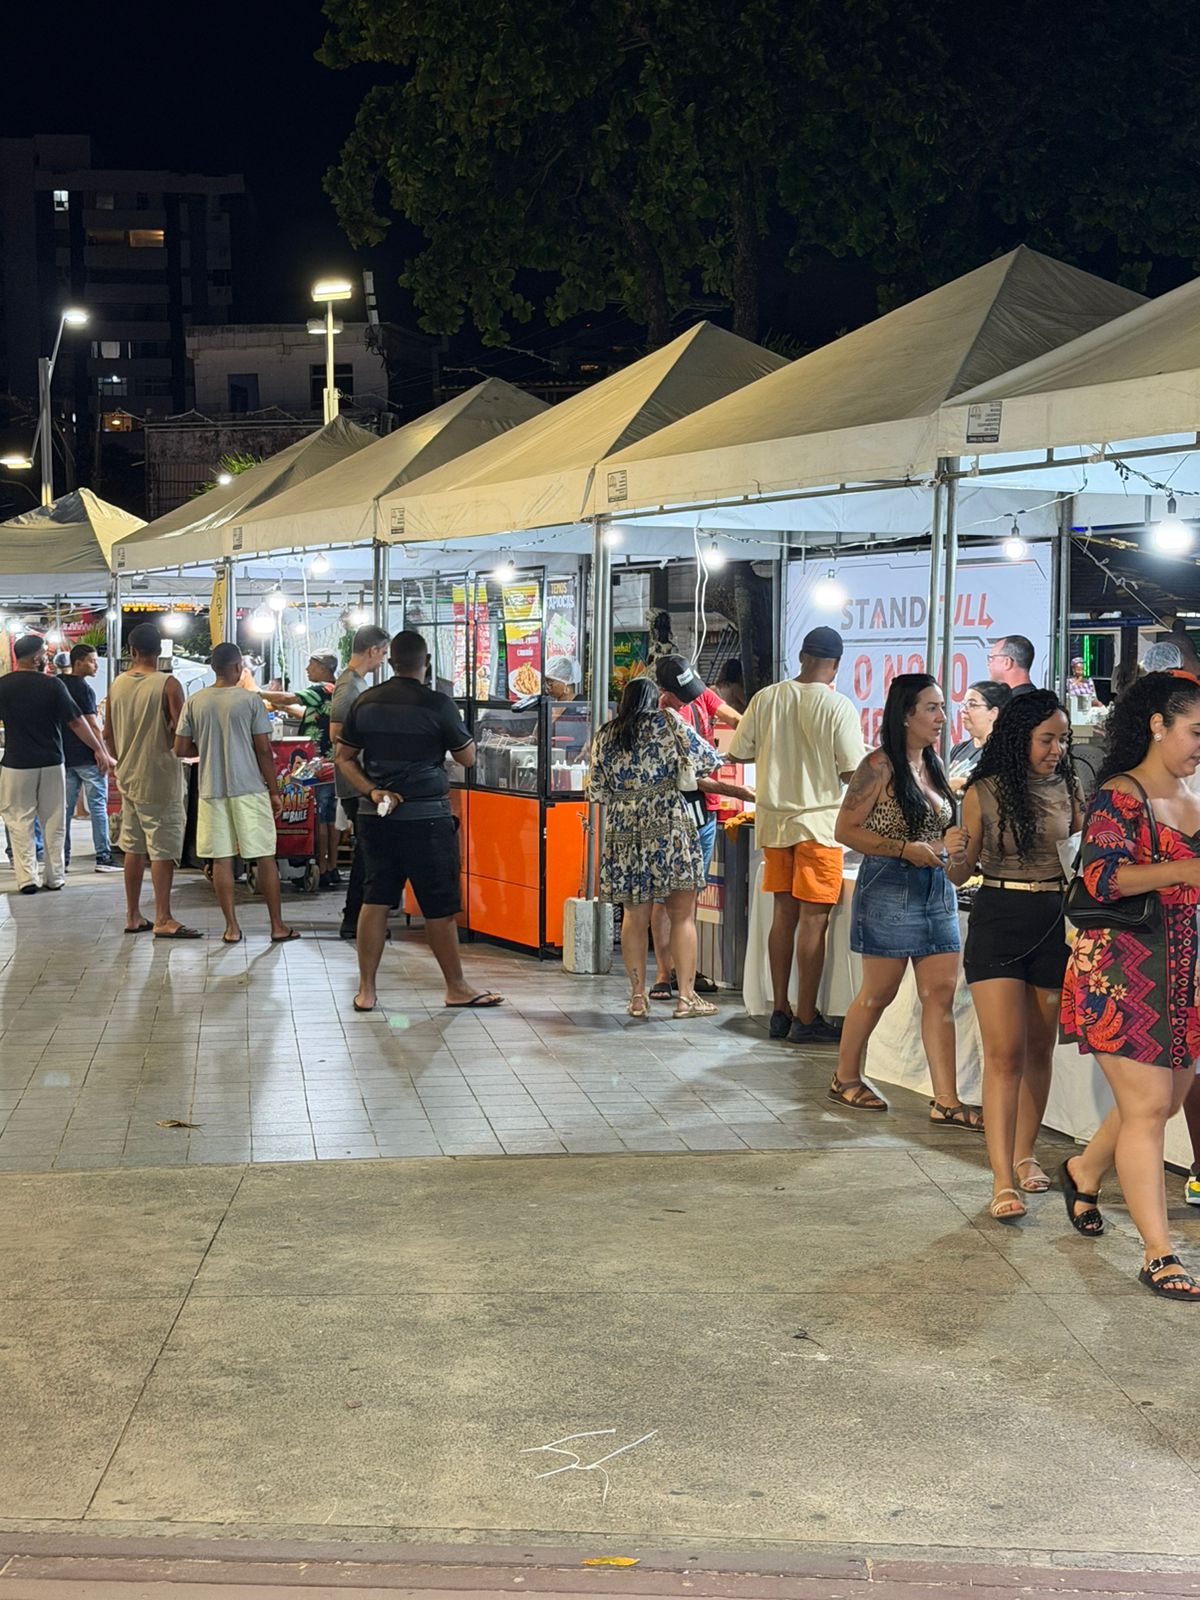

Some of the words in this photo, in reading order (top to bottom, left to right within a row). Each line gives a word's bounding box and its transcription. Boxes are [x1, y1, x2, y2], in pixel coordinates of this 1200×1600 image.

[840, 596, 926, 630] STAND
[937, 593, 994, 629] ULL
[853, 655, 872, 701] O
[884, 653, 968, 702] NOO
[697, 886, 720, 907] AHMA
